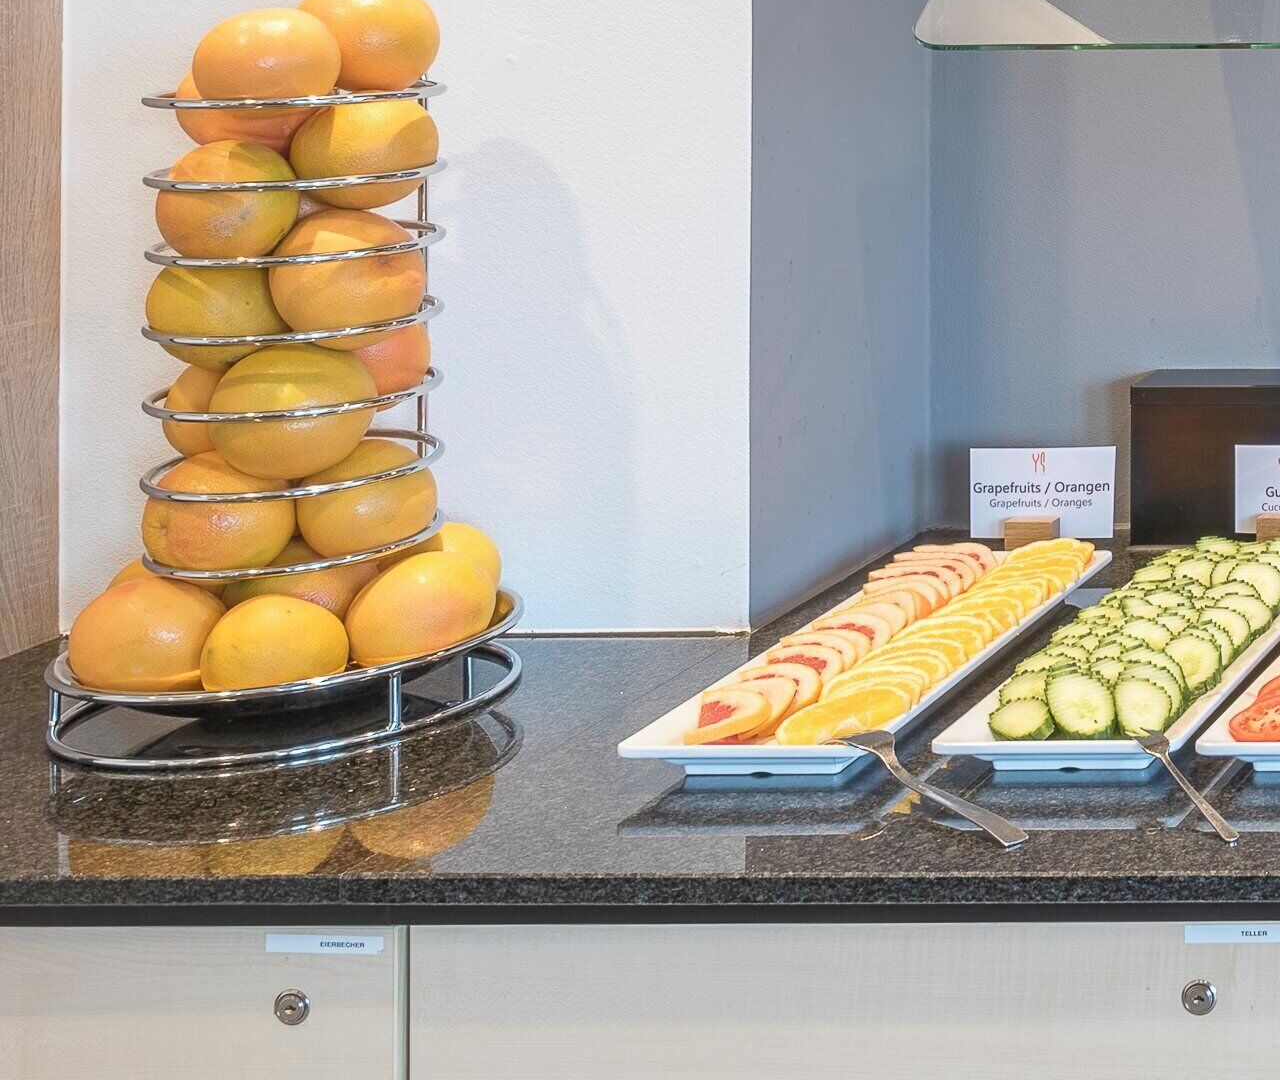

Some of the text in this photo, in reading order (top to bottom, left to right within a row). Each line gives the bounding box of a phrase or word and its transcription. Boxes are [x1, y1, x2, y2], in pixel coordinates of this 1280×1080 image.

[973, 482, 1041, 496] Grapefruits
[1054, 481, 1110, 495] Orangen
[989, 498, 1042, 509] Grapefruits
[1052, 498, 1092, 509] Oranges
